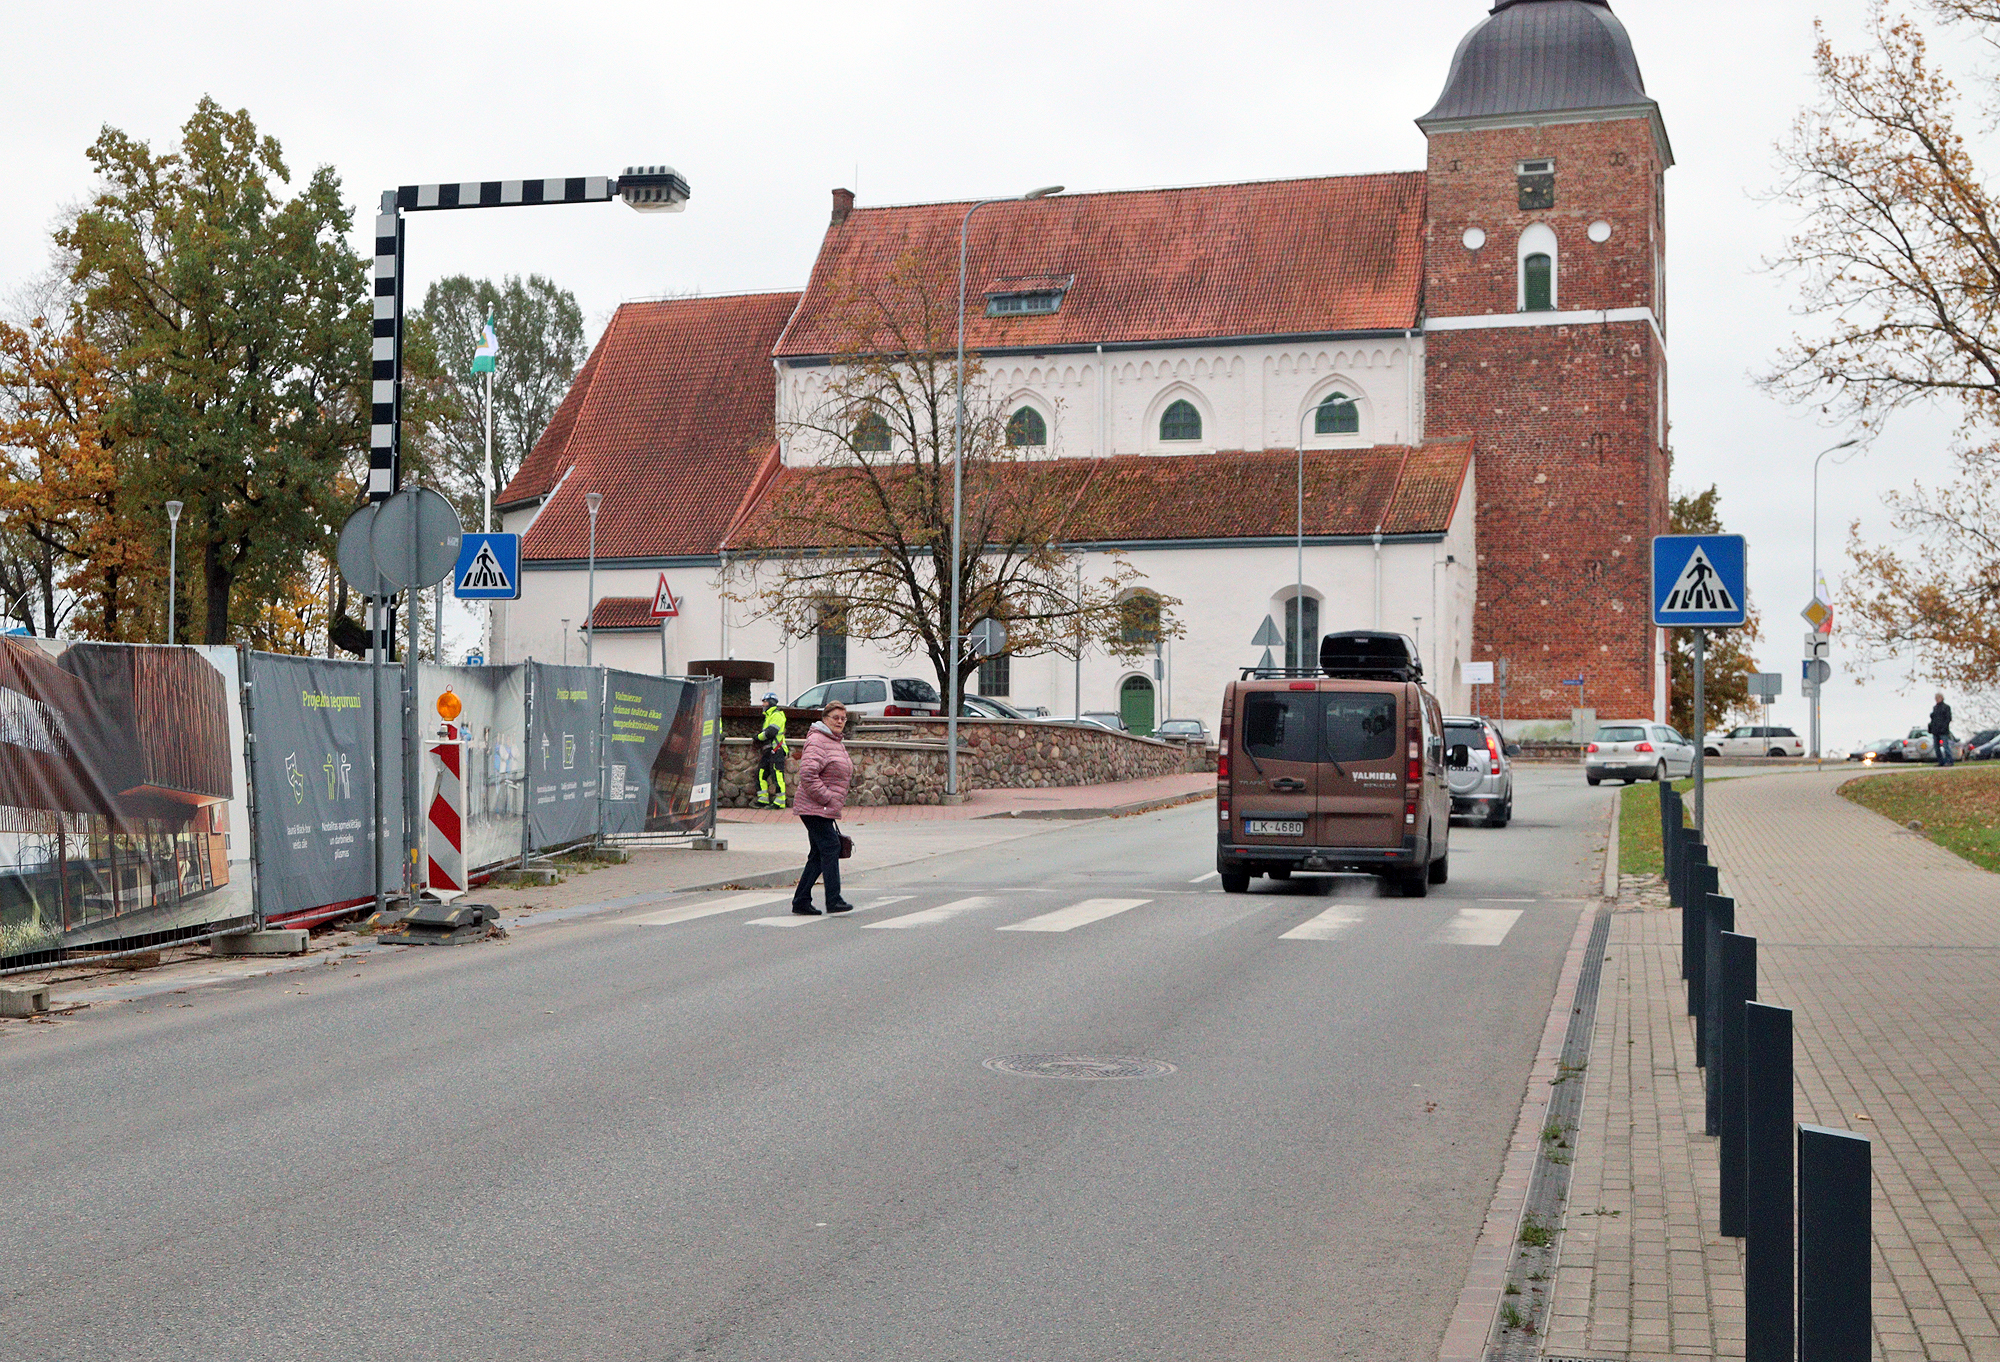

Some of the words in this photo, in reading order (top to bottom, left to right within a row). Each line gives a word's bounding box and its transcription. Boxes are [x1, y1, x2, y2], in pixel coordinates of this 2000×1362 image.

[302, 690, 330, 711] Projekta
[1352, 771, 1397, 782] VALMIERA
[1253, 821, 1302, 832] LK-4680
